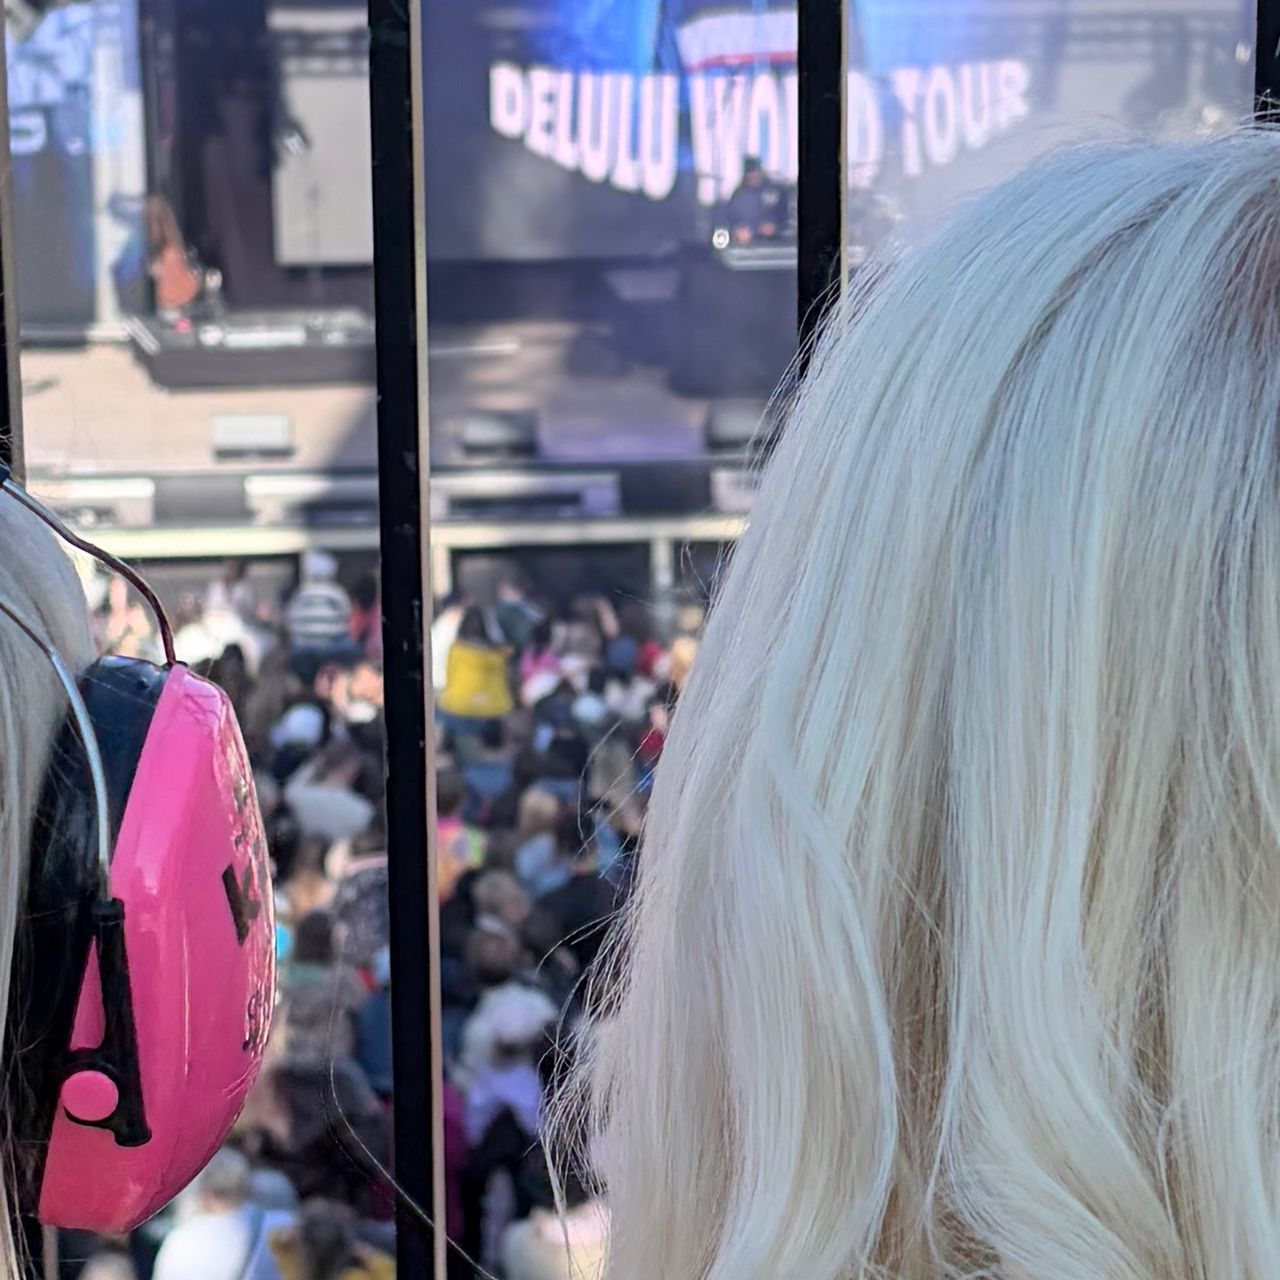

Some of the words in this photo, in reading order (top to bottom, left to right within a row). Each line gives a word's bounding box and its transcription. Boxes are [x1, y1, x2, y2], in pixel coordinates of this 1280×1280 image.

[489, 61, 680, 200] DELULU
[689, 70, 880, 207] WOD
[890, 60, 1031, 177] TOUR
